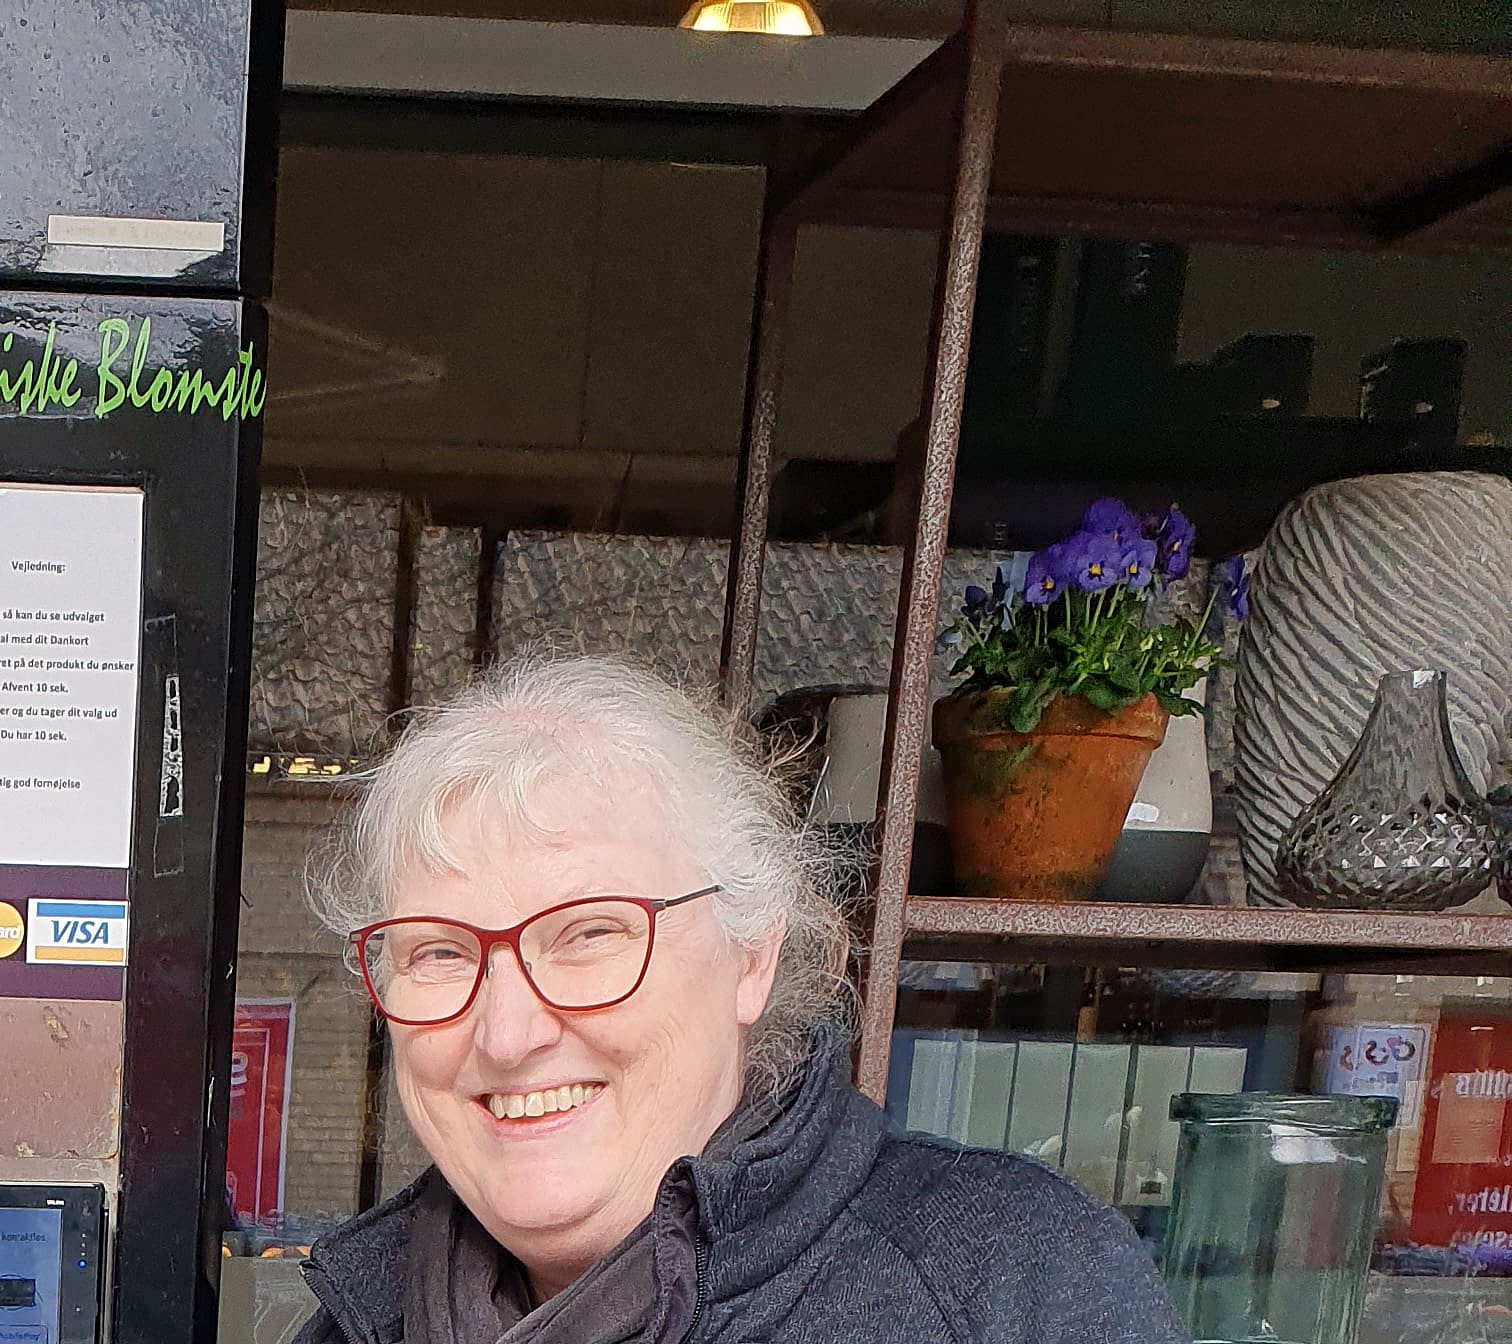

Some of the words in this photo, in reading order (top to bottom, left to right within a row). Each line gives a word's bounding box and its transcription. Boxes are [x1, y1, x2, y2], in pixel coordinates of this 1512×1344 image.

[11, 560, 66, 574] Vejledning:
[3, 608, 13, 619] så
[15, 609, 32, 619] kan
[36, 610, 48, 620] du
[50, 612, 61, 621] se
[63, 611, 105, 623] udvalget
[12, 634, 32, 644] med
[35, 635, 48, 645] dit
[51, 635, 89, 645] Dankort
[14, 657, 25, 670] på
[28, 658, 44, 669] det
[46, 659, 84, 672] produkt
[87, 660, 99, 670] du
[102, 660, 135, 672] ønsker
[1, 681, 33, 692] Afvent
[37, 682, 48, 692] 10
[50, 683, 69, 693] sek.
[11, 707, 24, 718] og
[26, 706, 38, 716] du
[40, 707, 65, 719] tager
[67, 707, 80, 717] dit
[82, 708, 102, 720] valg
[105, 708, 117, 718] ud
[0, 729, 14, 740] Du
[16, 730, 33, 740] har
[35, 730, 46, 741] 10
[48, 731, 67, 741] sek.
[13, 777, 31, 789] god
[33, 778, 81, 790] fornøjelse
[50, 919, 109, 944] VISA
